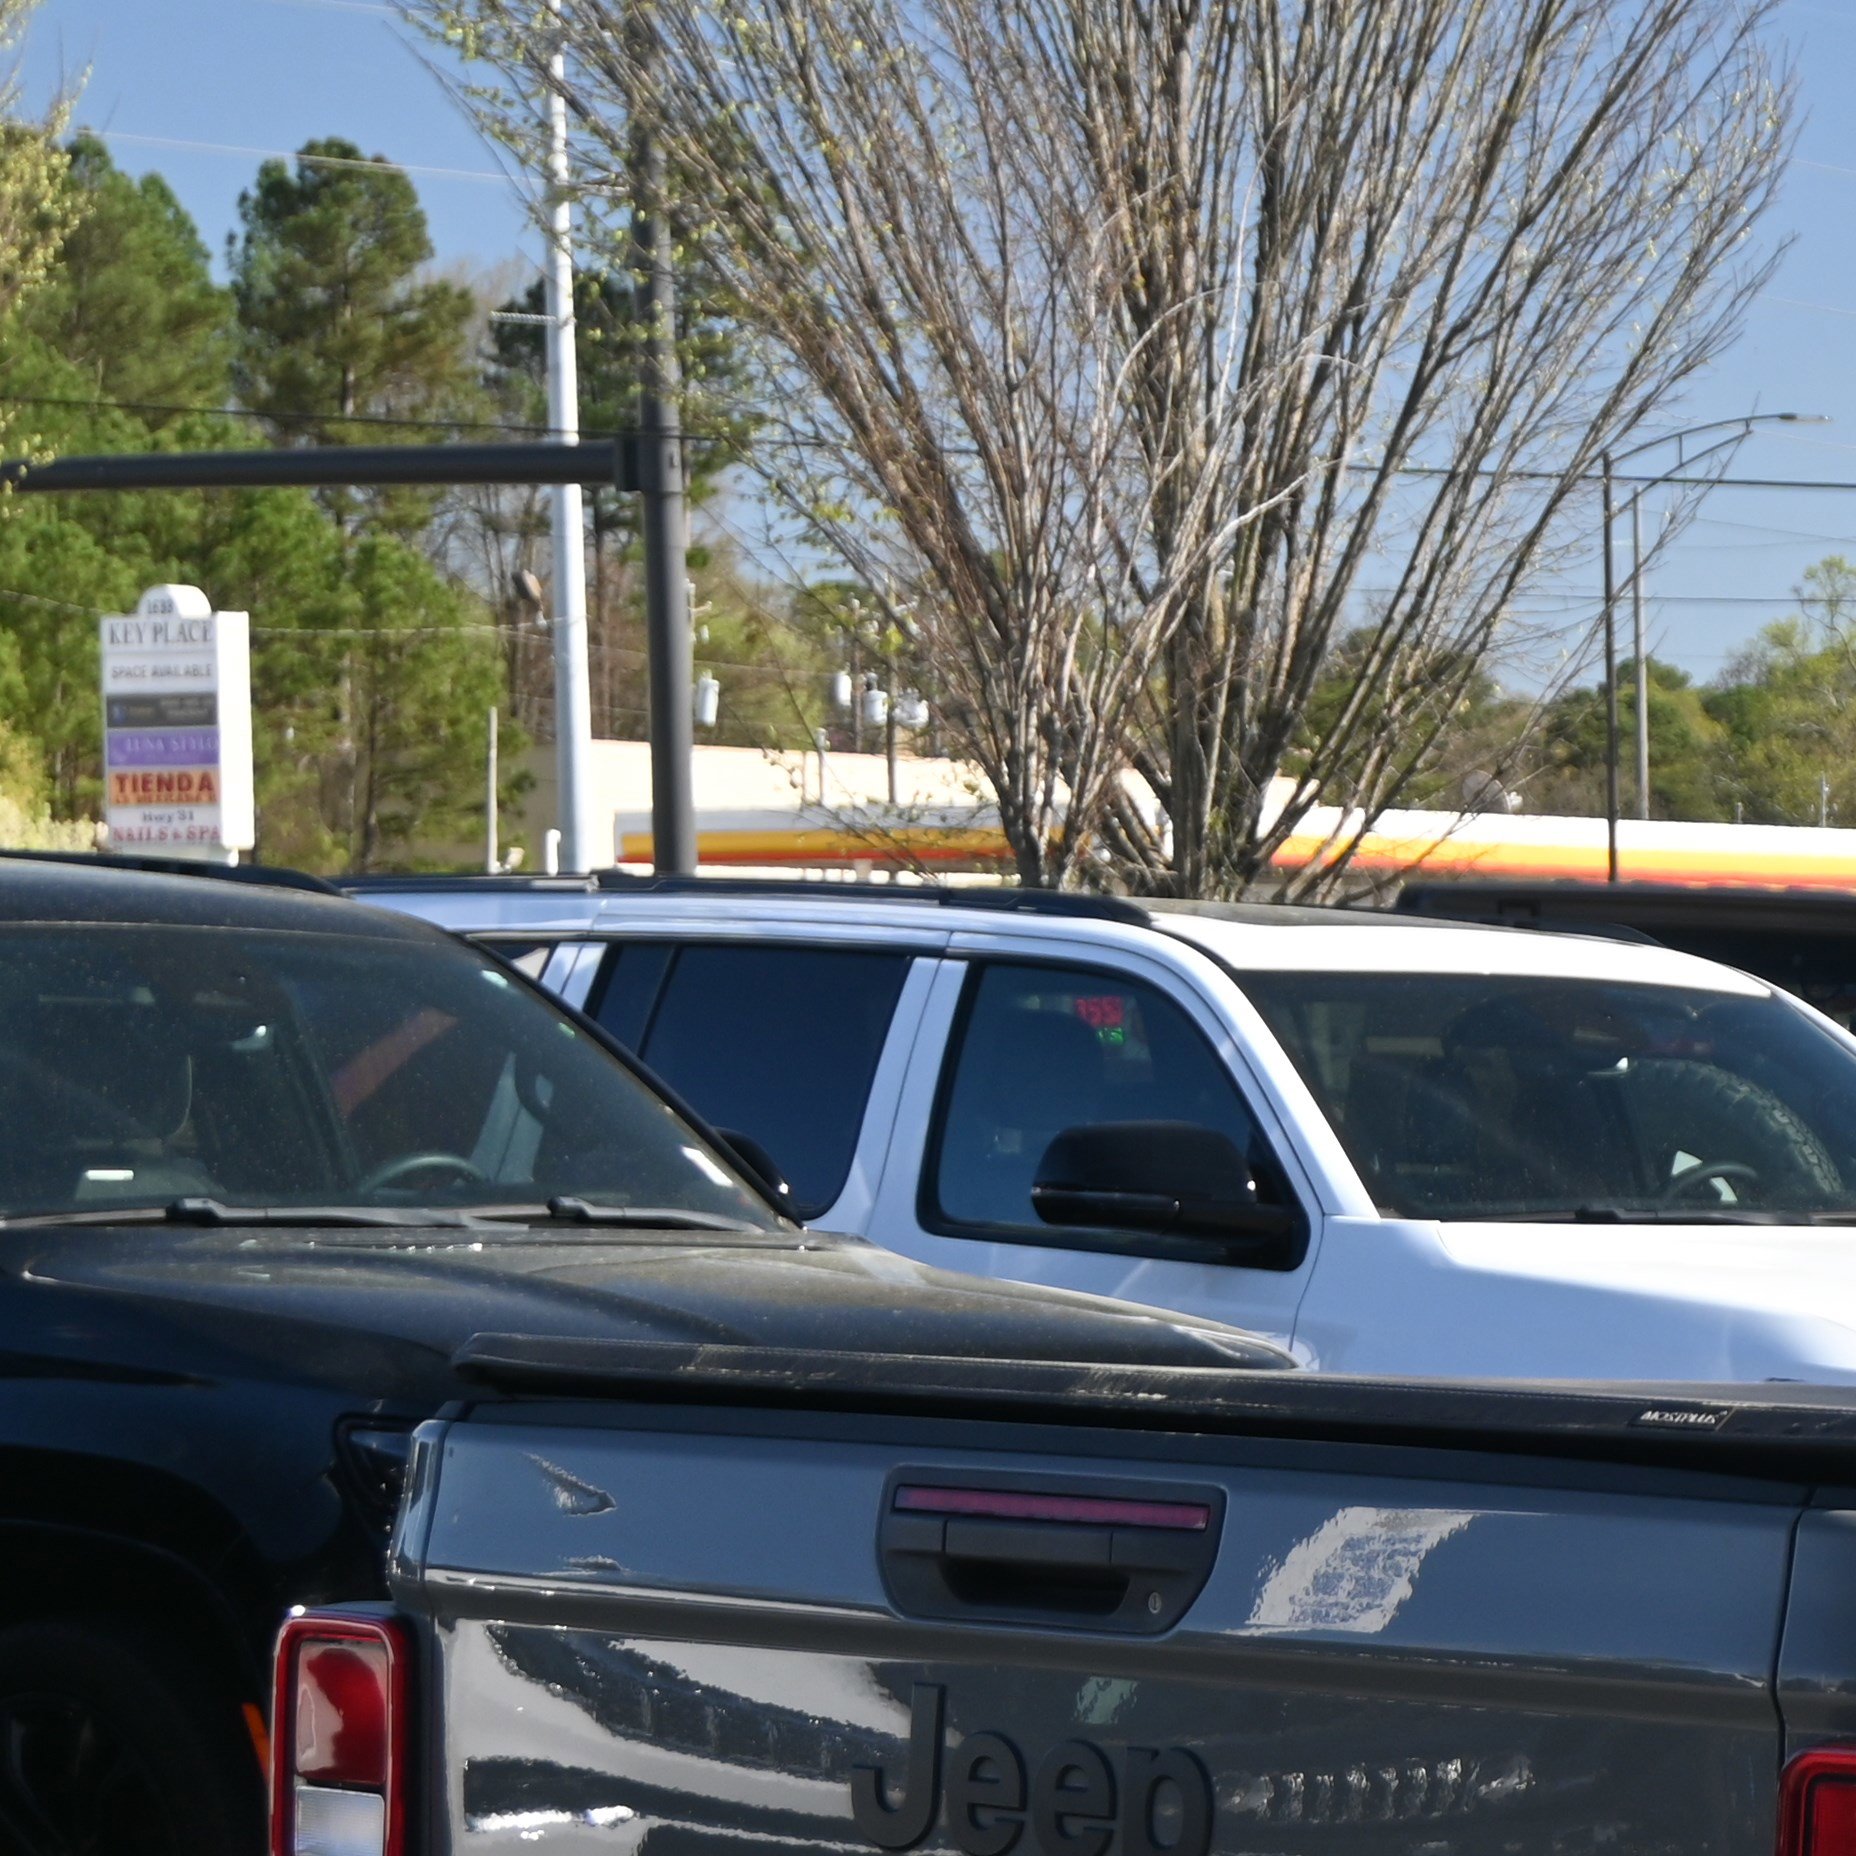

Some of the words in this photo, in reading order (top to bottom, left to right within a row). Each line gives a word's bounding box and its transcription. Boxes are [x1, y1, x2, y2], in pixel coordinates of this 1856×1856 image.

[110, 622, 145, 644] KEY
[152, 621, 212, 643] PLACE
[112, 665, 146, 678] SPACE
[151, 663, 212, 677] AVAILABLE
[115, 772, 214, 792] TIENDA
[143, 810, 172, 823] Hwy
[113, 826, 168, 841] NAILS
[186, 824, 220, 841] SPA
